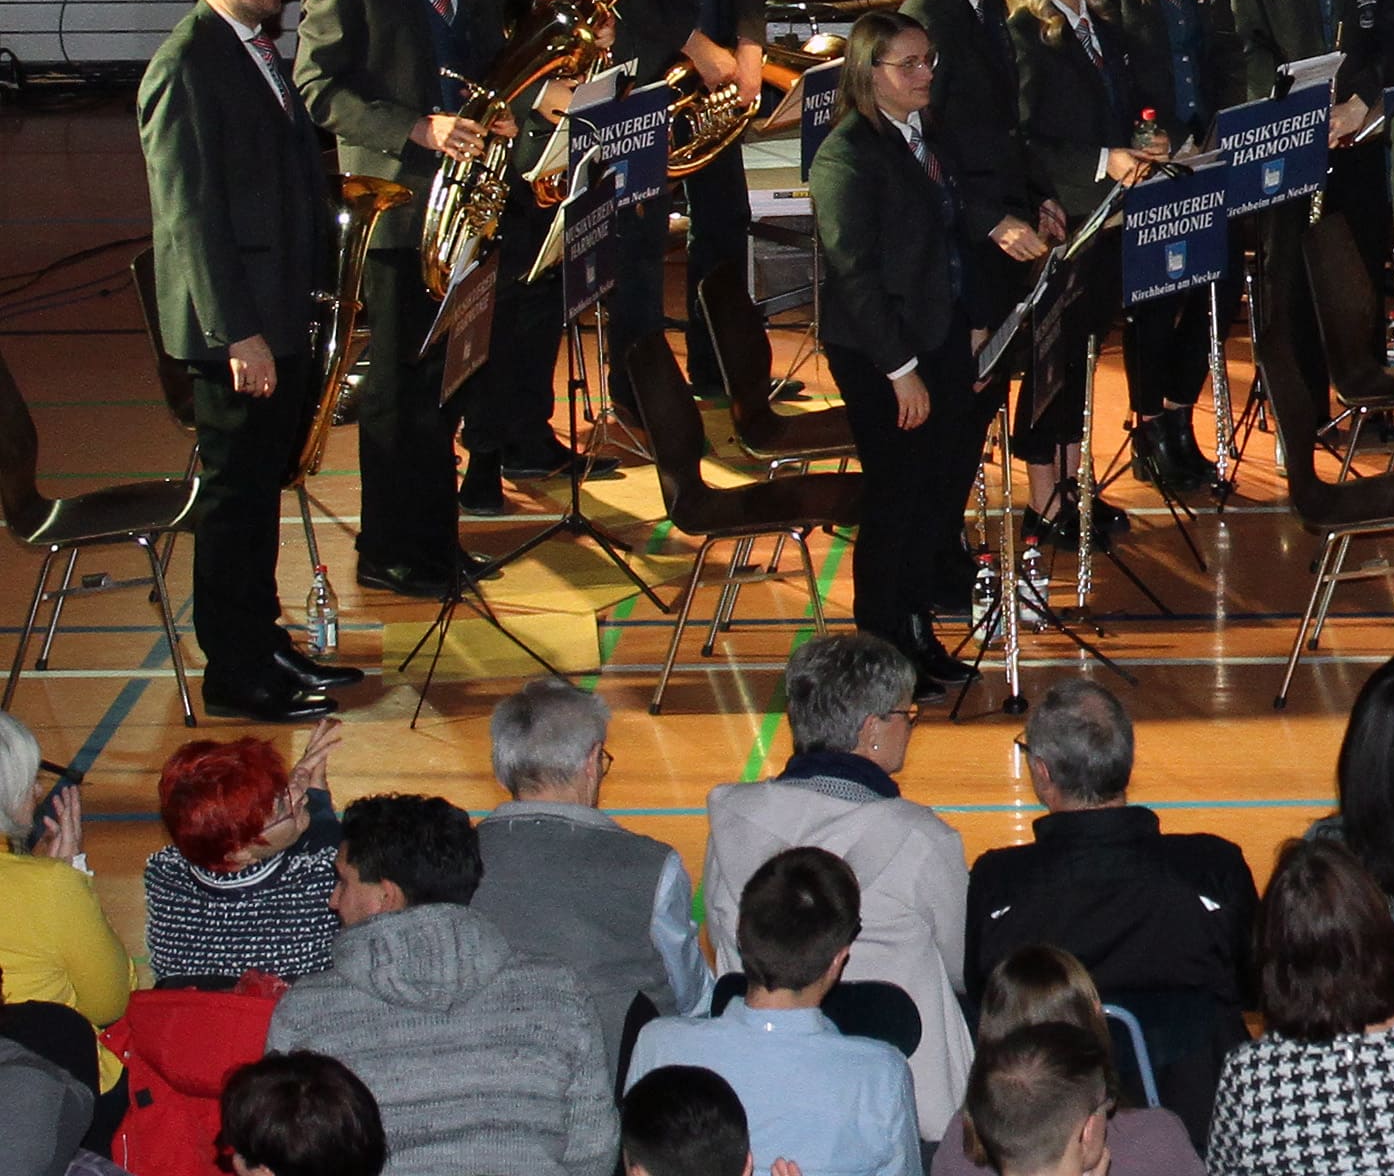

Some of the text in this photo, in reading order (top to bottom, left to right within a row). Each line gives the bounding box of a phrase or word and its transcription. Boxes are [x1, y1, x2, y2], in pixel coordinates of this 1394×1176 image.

[601, 130, 655, 161] RMONIE
[1219, 107, 1327, 152] MUSIKVEREIN
[1232, 128, 1315, 167] HARMONIE
[632, 186, 660, 202] Neckar
[1271, 193, 1286, 204] am
[1287, 182, 1319, 200] Neckar
[1125, 190, 1225, 230] MUSIKVEREIN
[1137, 212, 1214, 246] HARMONIE
[1131, 271, 1221, 302] Kirchheim am Neckar
